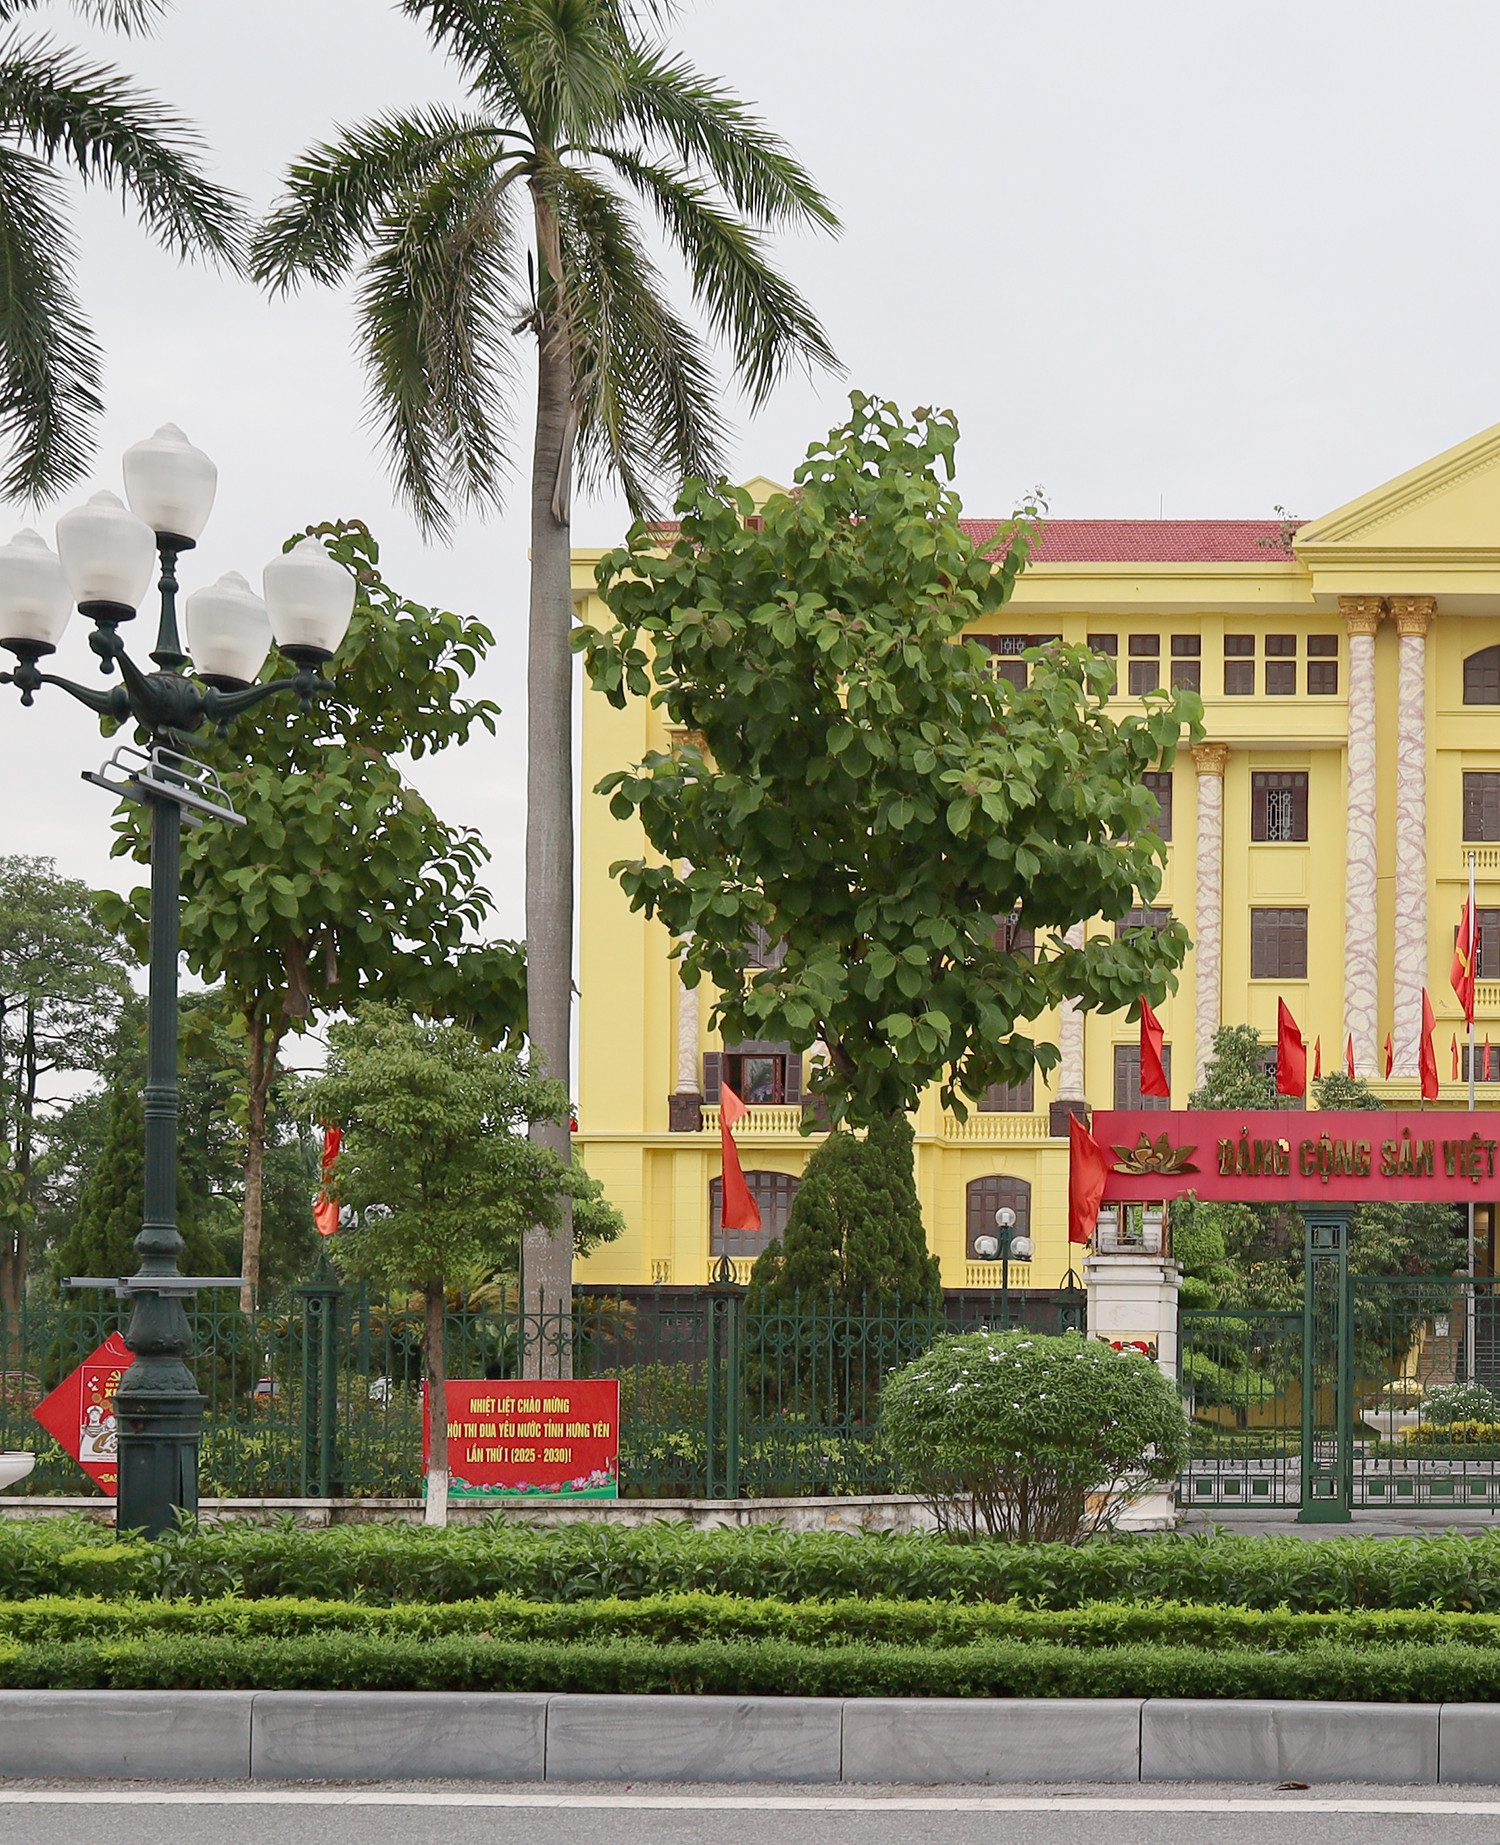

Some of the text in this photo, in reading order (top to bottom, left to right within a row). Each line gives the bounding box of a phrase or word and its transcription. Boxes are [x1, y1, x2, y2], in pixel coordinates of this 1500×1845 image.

[1217, 1126, 1290, 1176] ĐẢNG
[1299, 1131, 1371, 1183] CỘNG
[1380, 1127, 1434, 1176] SẢN
[1442, 1131, 1499, 1183] VIỆT
[104, 1388, 118, 1398] XI
[470, 1396, 570, 1416] NHIỆT LIỆT CHÀO MỪNG
[447, 1418, 610, 1441] HỘI THI ĐUA YÊU NƯỚC TỈNH HƯNG YÊN
[486, 1445, 504, 1463] THỨ
[505, 1448, 509, 1462] I
[511, 1448, 535, 1464] (2025
[543, 1448, 572, 1464] 2030)!
